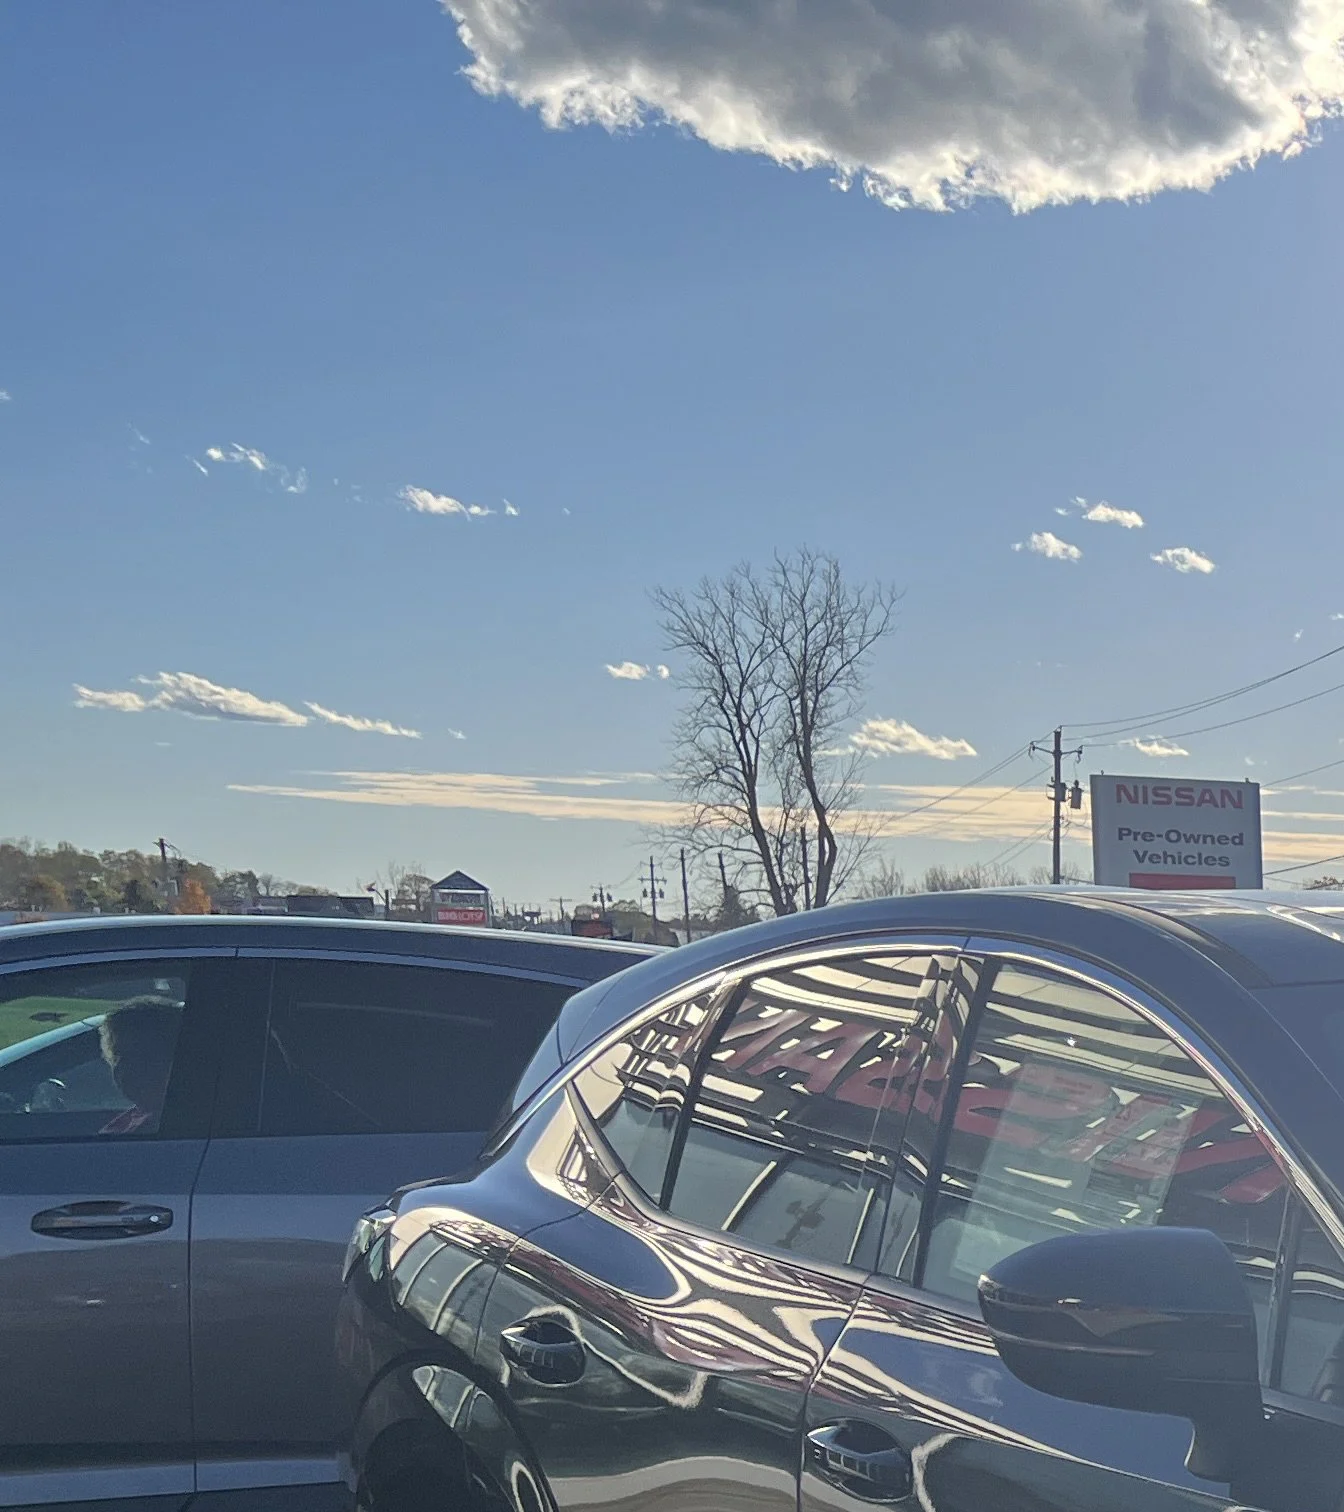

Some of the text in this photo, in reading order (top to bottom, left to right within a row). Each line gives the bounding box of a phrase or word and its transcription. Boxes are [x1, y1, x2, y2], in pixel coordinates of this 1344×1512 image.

[1116, 783, 1244, 809] NISSAN
[1117, 827, 1244, 846] Pre-Owned
[1133, 849, 1231, 867] Vehicles
